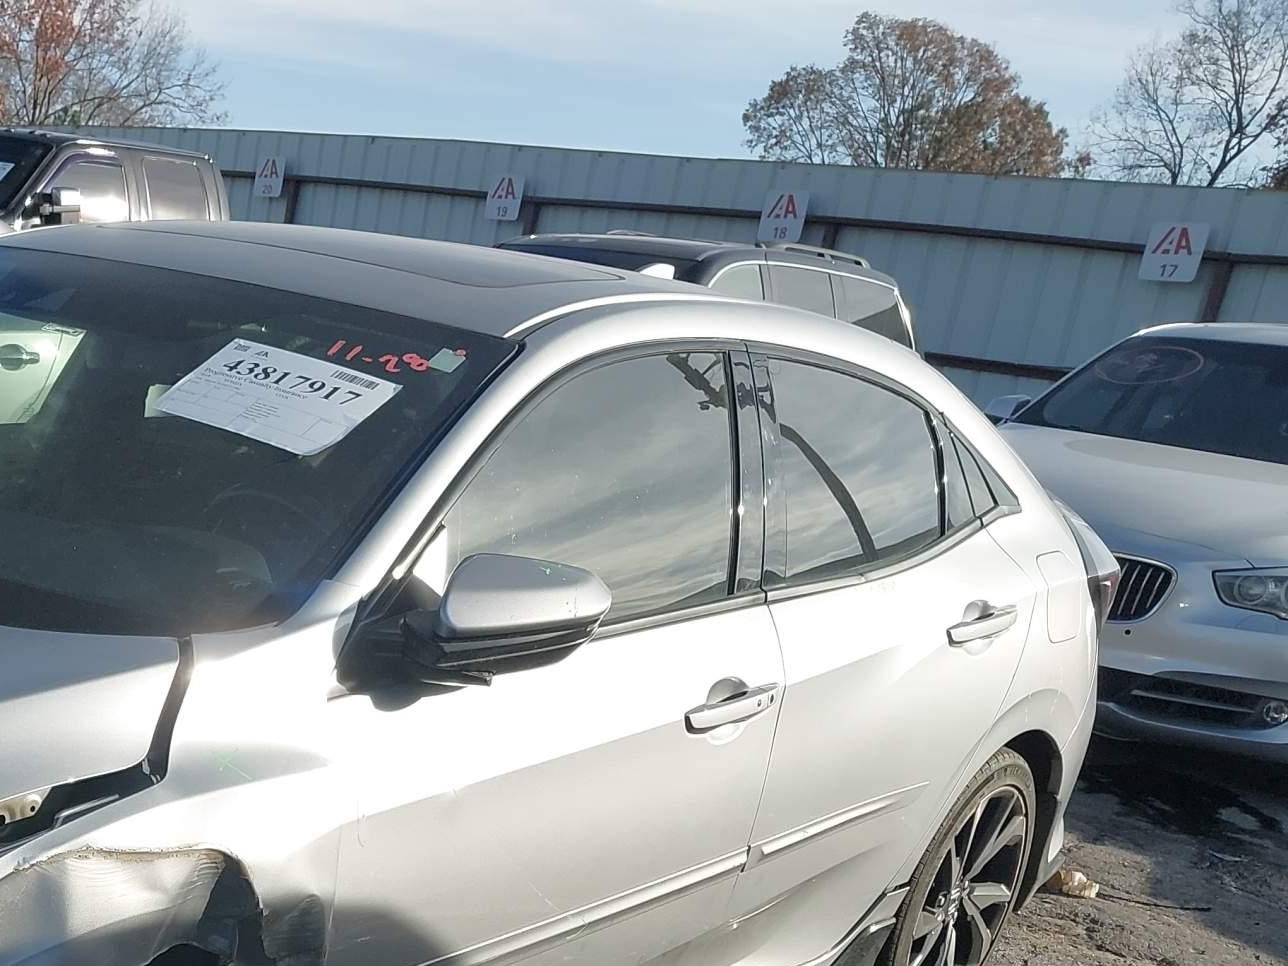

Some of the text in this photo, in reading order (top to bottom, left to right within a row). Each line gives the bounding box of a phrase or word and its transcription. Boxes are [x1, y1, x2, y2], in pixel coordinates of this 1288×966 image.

[497, 206, 508, 217] 19
[774, 226, 788, 239] 18
[1160, 263, 1179, 278] 17
[223, 359, 363, 406] 43817917
